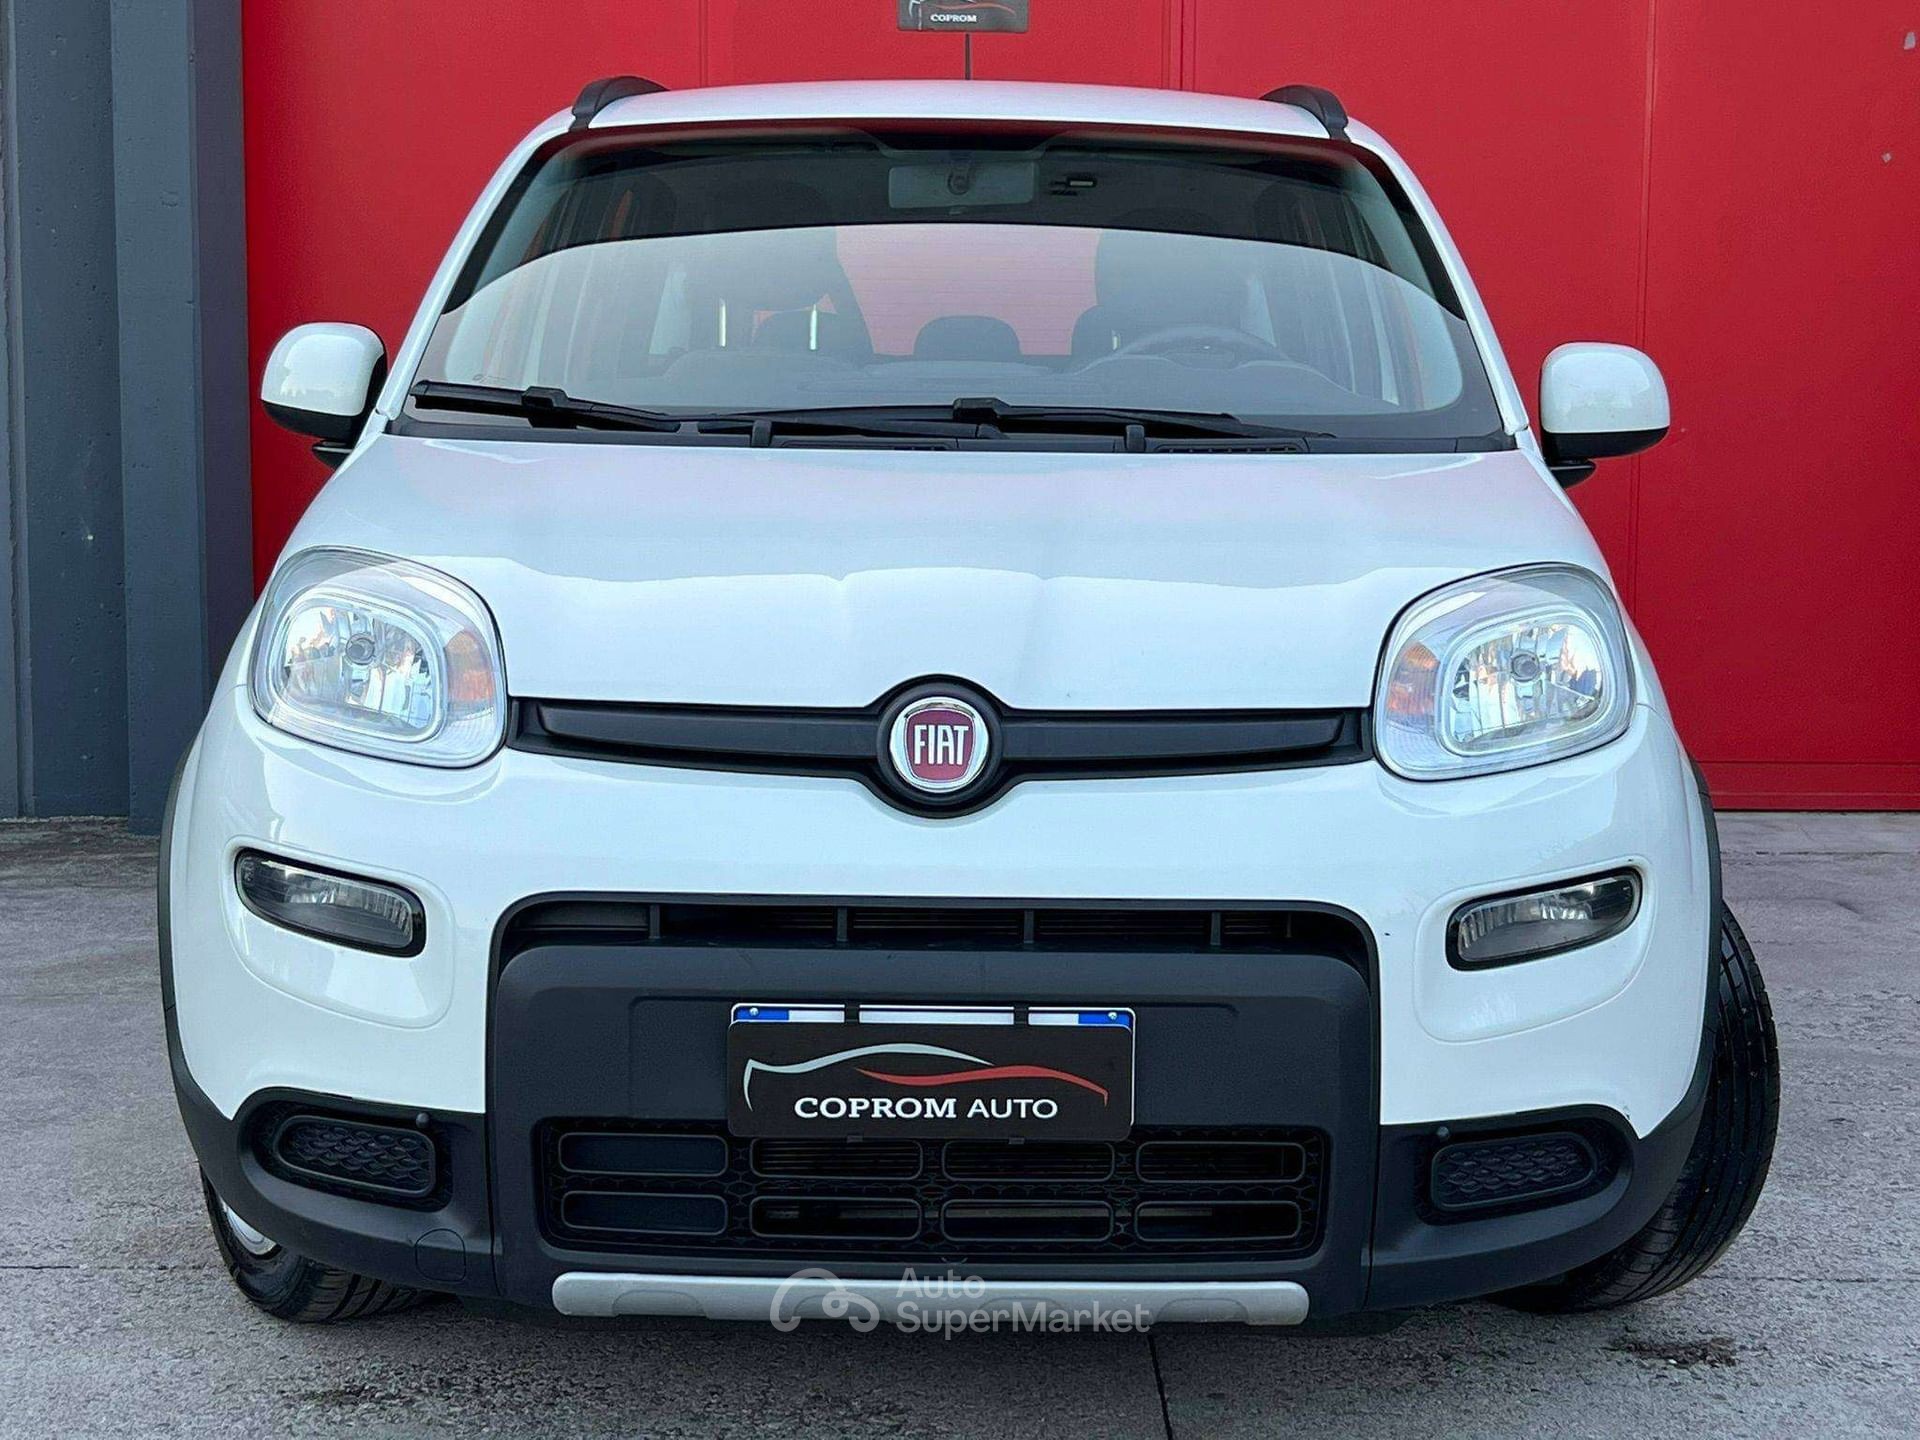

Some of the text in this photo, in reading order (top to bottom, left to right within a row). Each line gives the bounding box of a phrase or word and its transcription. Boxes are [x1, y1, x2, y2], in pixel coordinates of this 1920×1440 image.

[930, 13, 977, 22] COPROM
[914, 724, 969, 765] FIAT
[794, 1097, 1058, 1119] COPROM AUTO
